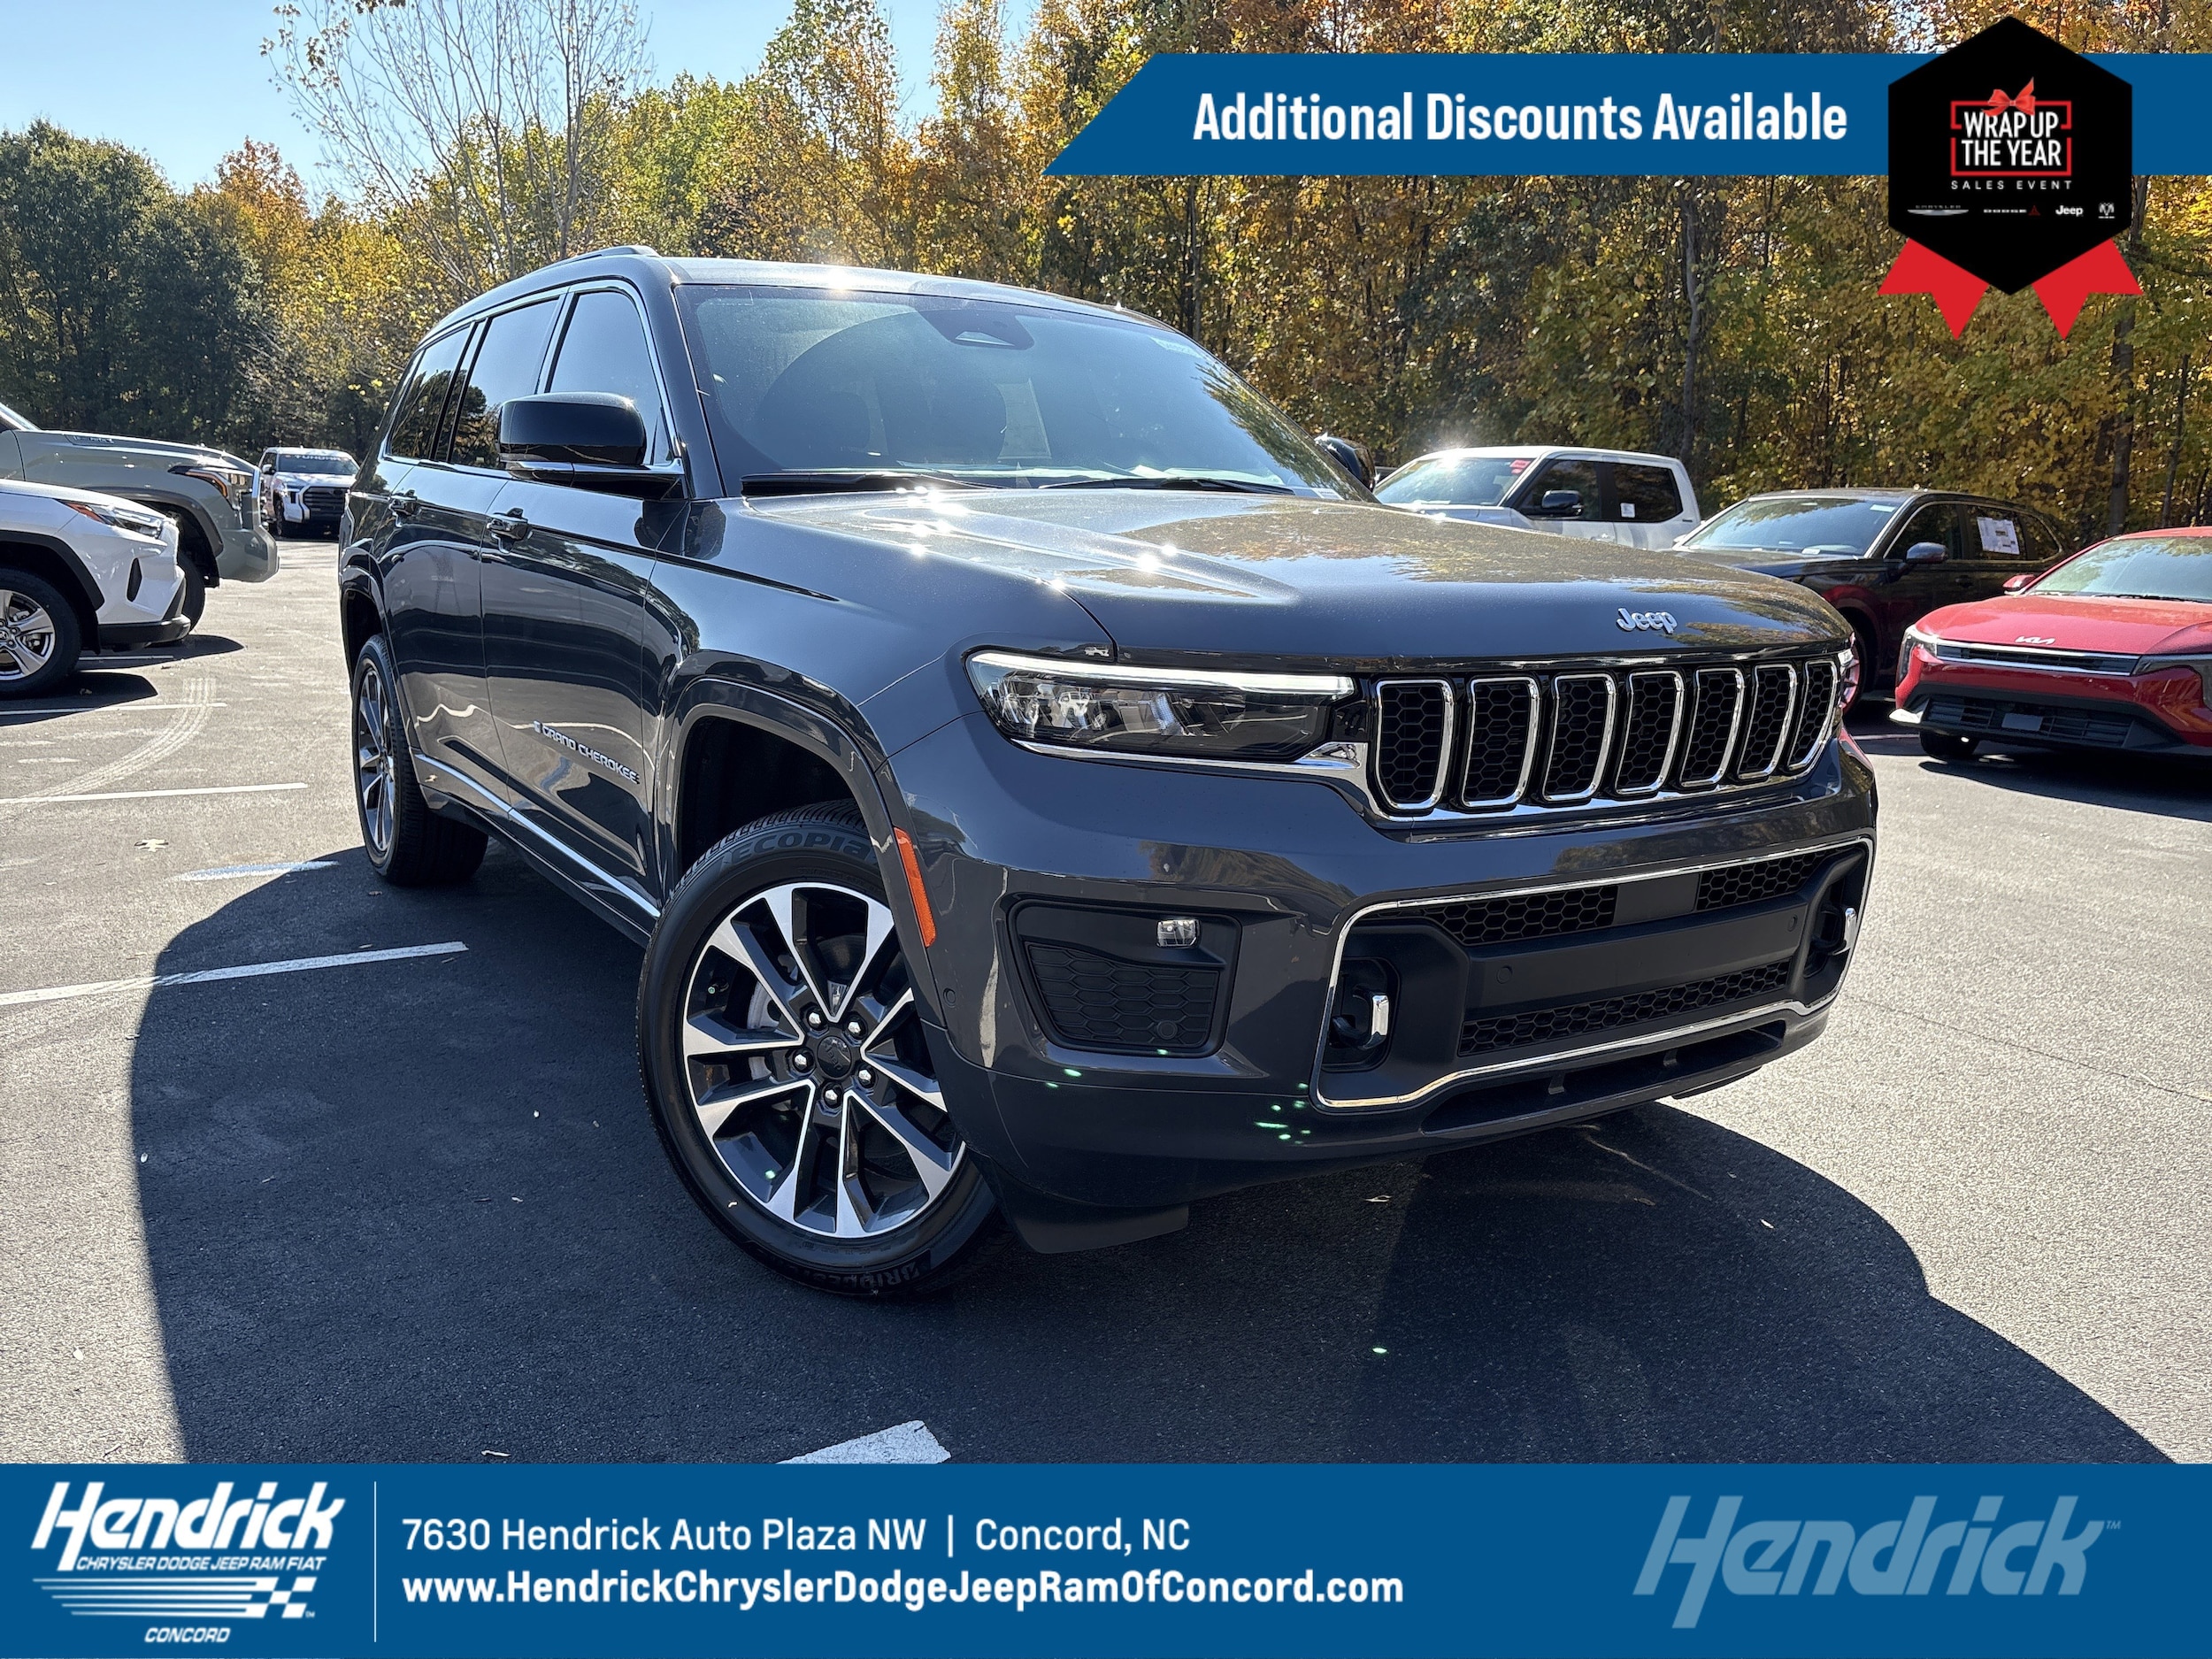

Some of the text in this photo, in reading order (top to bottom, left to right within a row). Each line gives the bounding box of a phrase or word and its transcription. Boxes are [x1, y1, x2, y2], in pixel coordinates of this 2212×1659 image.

[1617, 607, 1678, 634] Jeep
[541, 725, 640, 785] GRAND CHEROKEE
